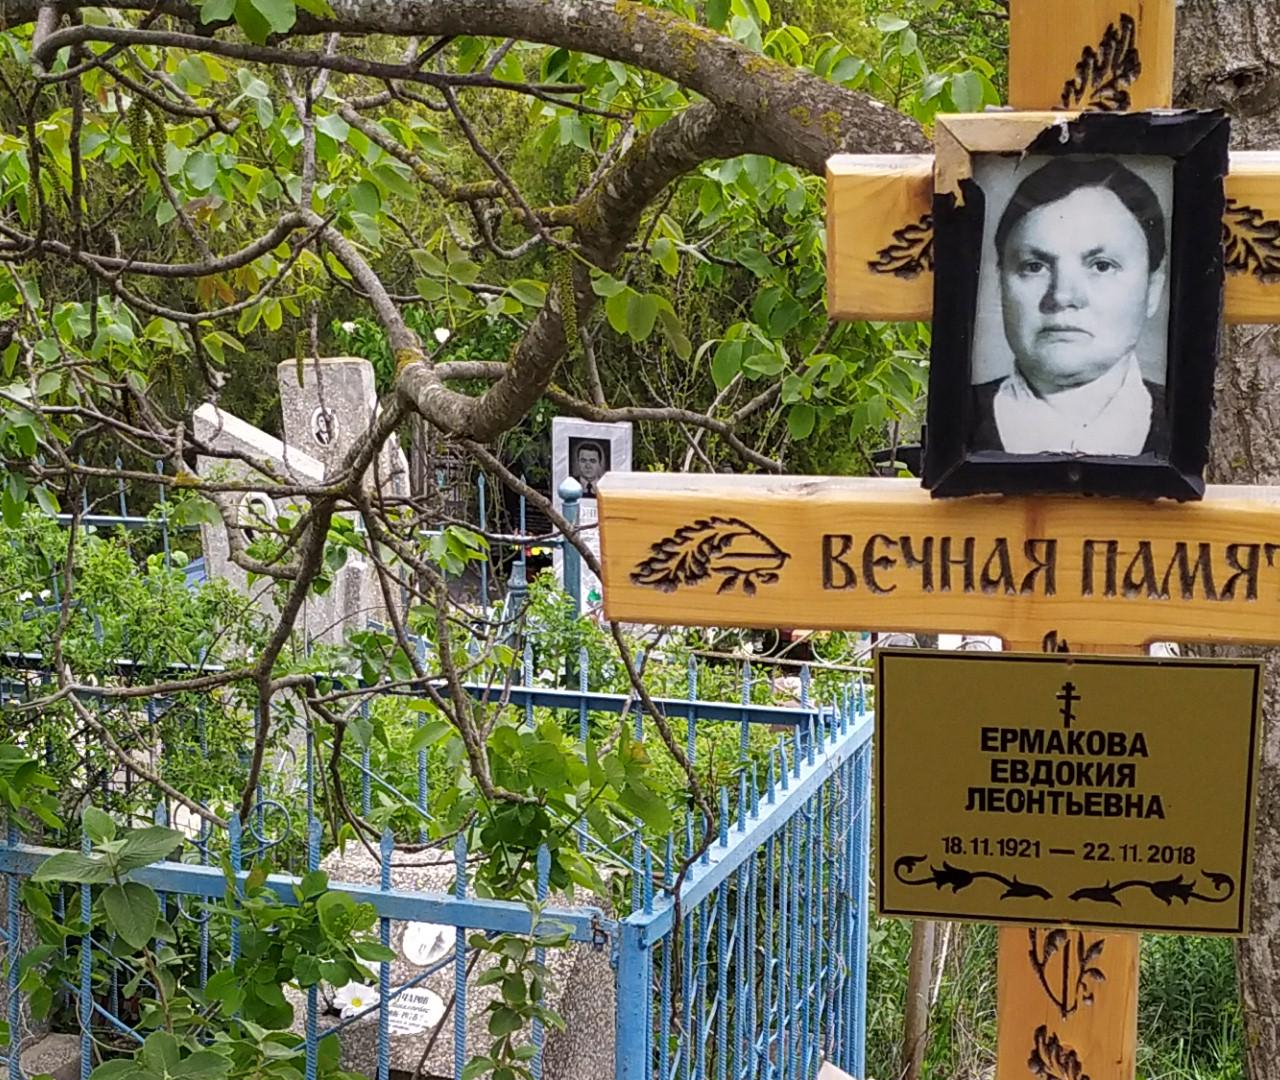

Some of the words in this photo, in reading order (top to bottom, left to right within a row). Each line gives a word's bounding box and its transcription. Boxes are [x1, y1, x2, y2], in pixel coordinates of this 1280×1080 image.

[821, 533, 1058, 596] ВЕЧНАЯ
[980, 726, 1149, 758] ЕРМАКОВА
[990, 758, 1137, 789] ЕВДОКИЯ
[964, 787, 1166, 820] ЛЕОНТЬЕВНА
[940, 835, 1041, 859] 18.11.1921
[1082, 841, 1197, 866] 22.11.2018
